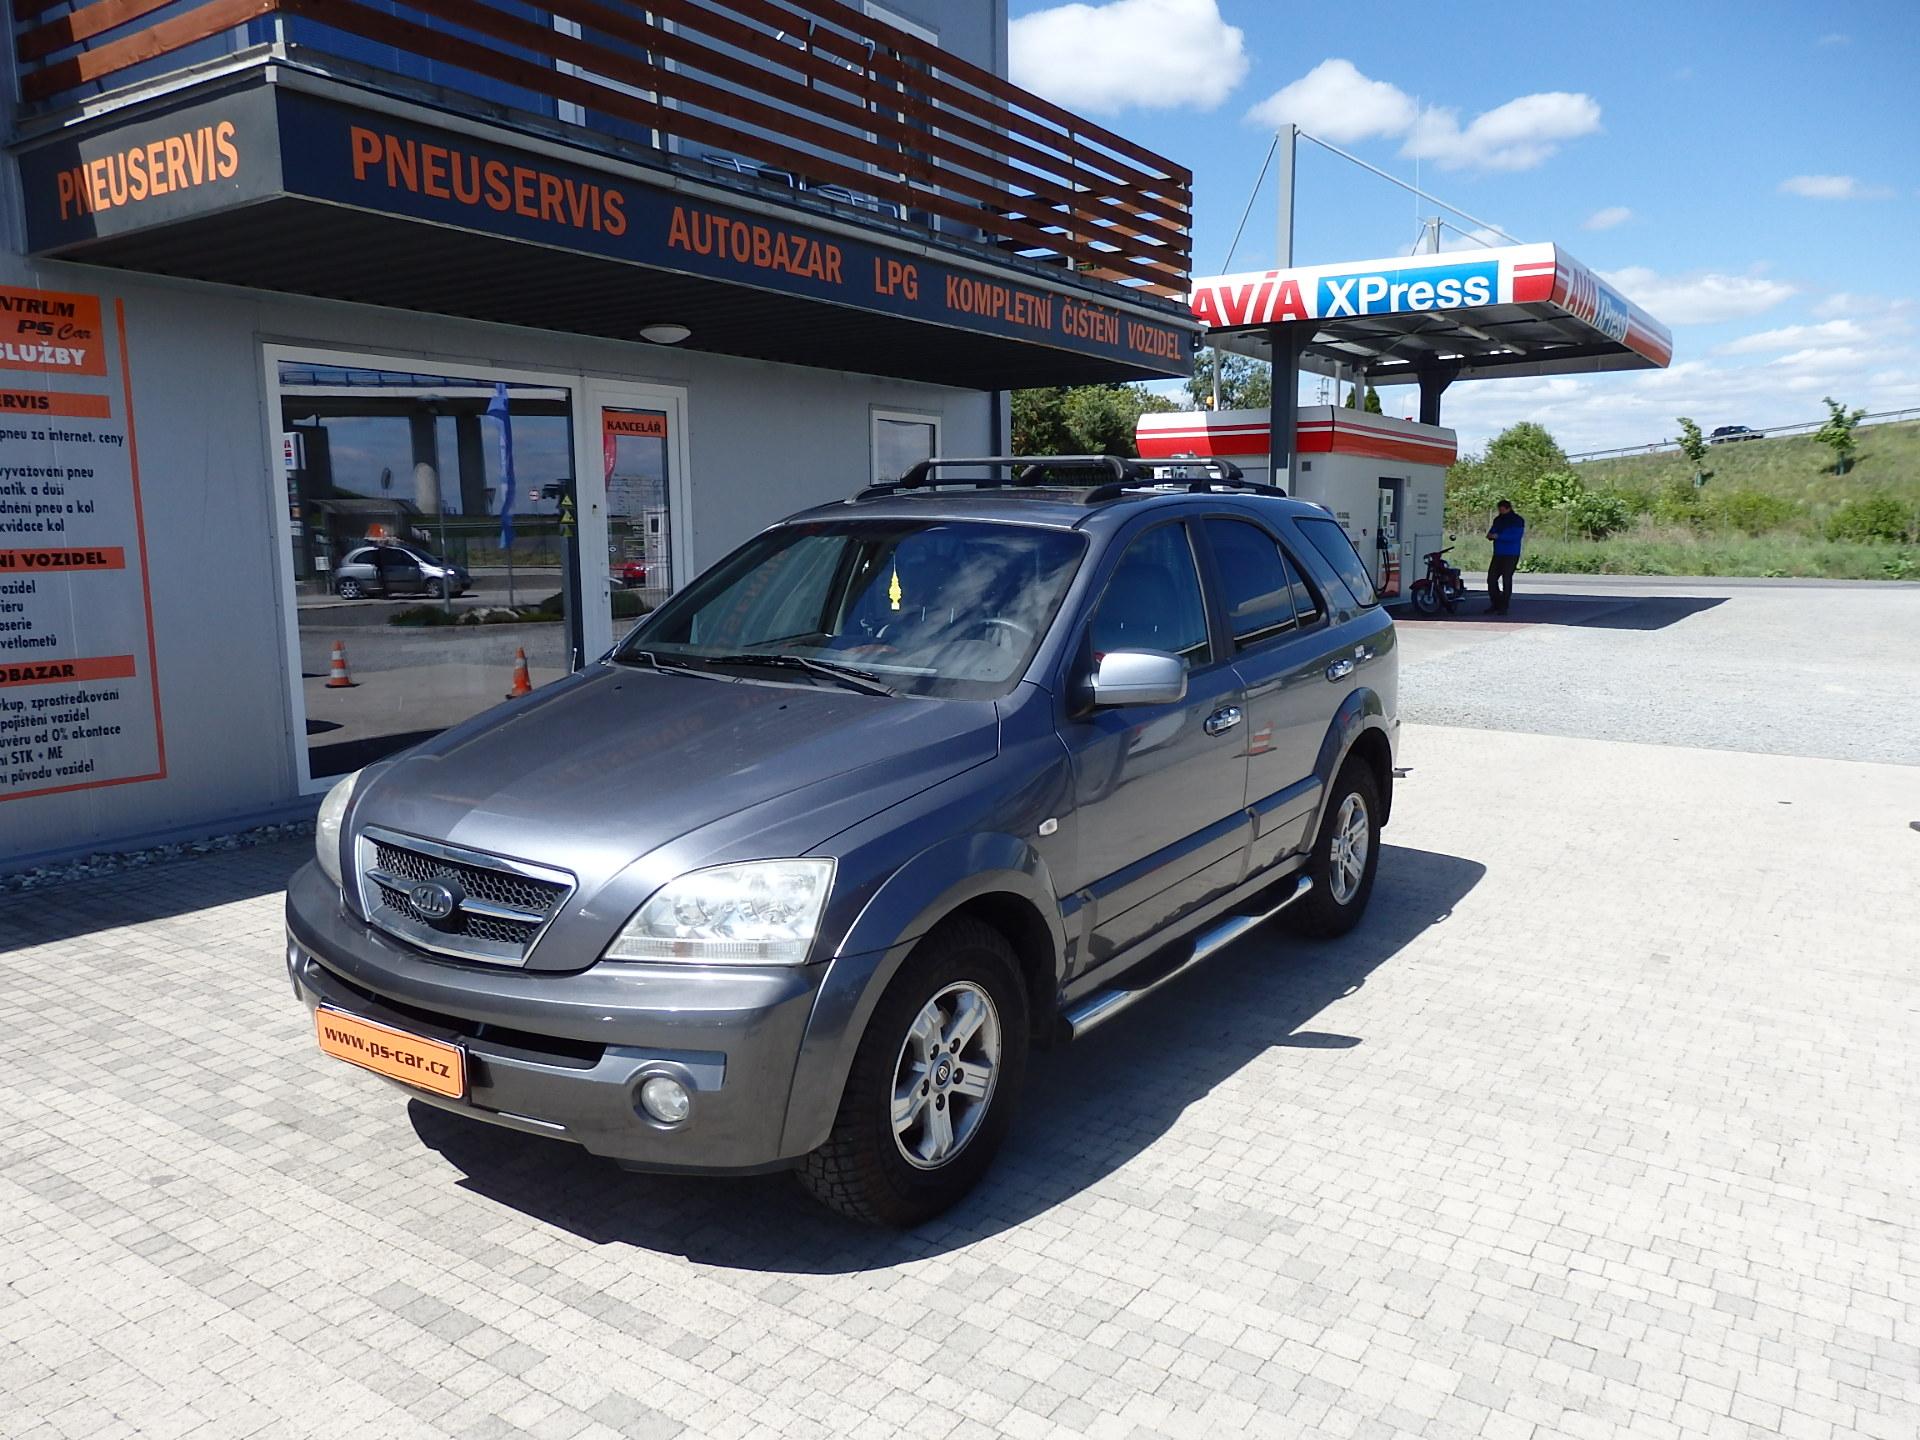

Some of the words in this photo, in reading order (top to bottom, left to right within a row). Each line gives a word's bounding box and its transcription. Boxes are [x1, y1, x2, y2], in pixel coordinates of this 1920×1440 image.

[57, 121, 240, 221] PNEUSERVIS
[350, 125, 627, 236] PNEUSERVIS
[668, 206, 843, 284] AUTOBAZAR
[873, 256, 918, 300] LPG
[1325, 276, 1490, 318] XPress
[945, 274, 1053, 330] KOMPLETNÍ
[1062, 297, 1120, 345] ČIŠTĚNÍ
[1127, 321, 1182, 361] VOZIDEL
[17, 319, 54, 336] PS
[0, 394, 49, 410] RVIS
[606, 420, 662, 434] KANCELÁŘ
[0, 429, 27, 442] pneu
[31, 430, 45, 441] za
[48, 428, 96, 443] internet.
[99, 435, 125, 448] ceny
[67, 467, 94, 480] pneu
[31, 486, 38, 495] a
[35, 504, 63, 517] pneu
[66, 504, 74, 513] a
[77, 500, 95, 513] kol
[47, 518, 65, 532] kol
[22, 552, 107, 567] VOZIDEL
[0, 634, 57, 649] větlometů
[51, 708, 90, 724] vozidel
[35, 730, 49, 744] od
[72, 725, 121, 740] akontace
[11, 749, 34, 765] STK
[48, 746, 64, 760] ME
[11, 766, 52, 786] původu
[56, 759, 95, 776] vozidel
[417, 887, 445, 912] KIA
[324, 1026, 451, 1078] www.ps-car.cz
